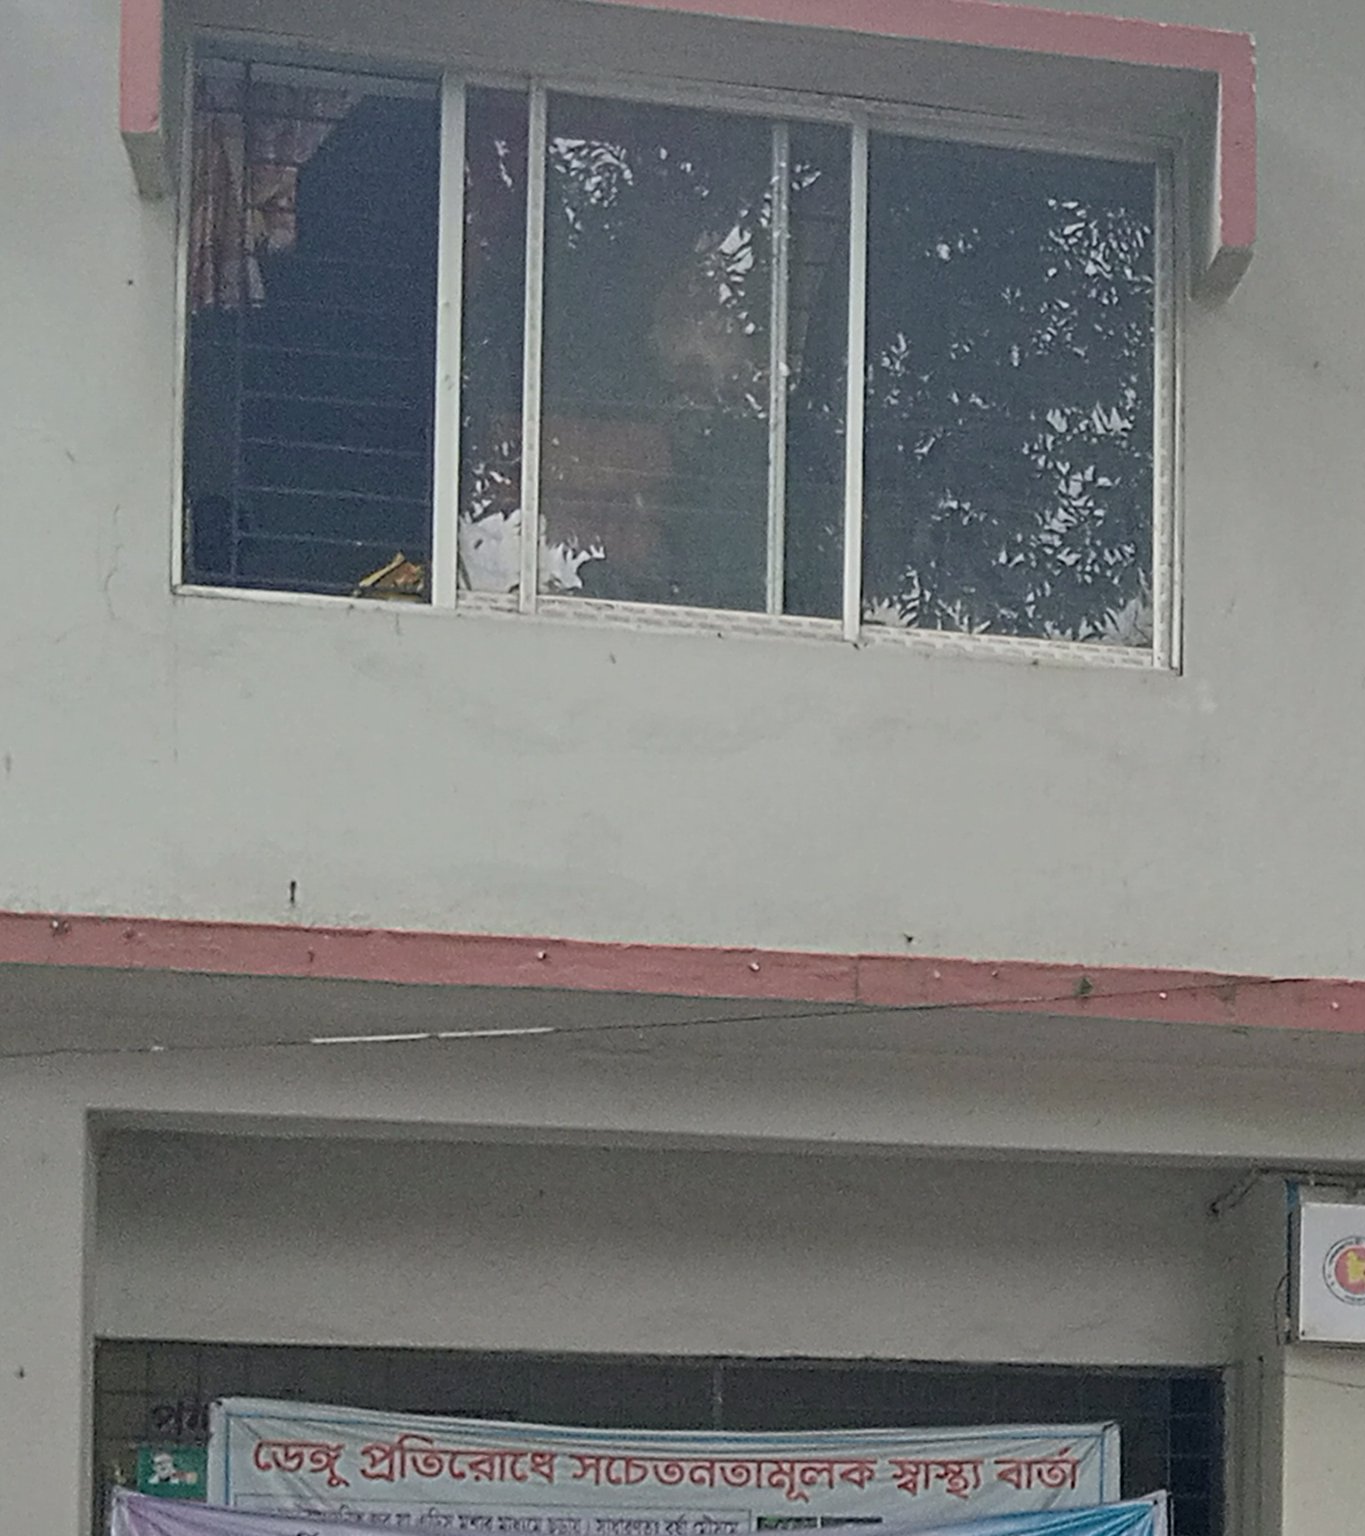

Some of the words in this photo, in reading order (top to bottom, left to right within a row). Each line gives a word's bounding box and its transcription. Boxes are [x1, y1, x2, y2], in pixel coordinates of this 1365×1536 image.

[253, 1437, 350, 1488] ডেঙ্গু
[360, 1433, 559, 1486] প্রতিরোধে
[570, 1452, 880, 1503] সচেতনতামূলক
[889, 1457, 984, 1500] স্বাস্থ্য
[994, 1448, 1081, 1491] বার্তা
